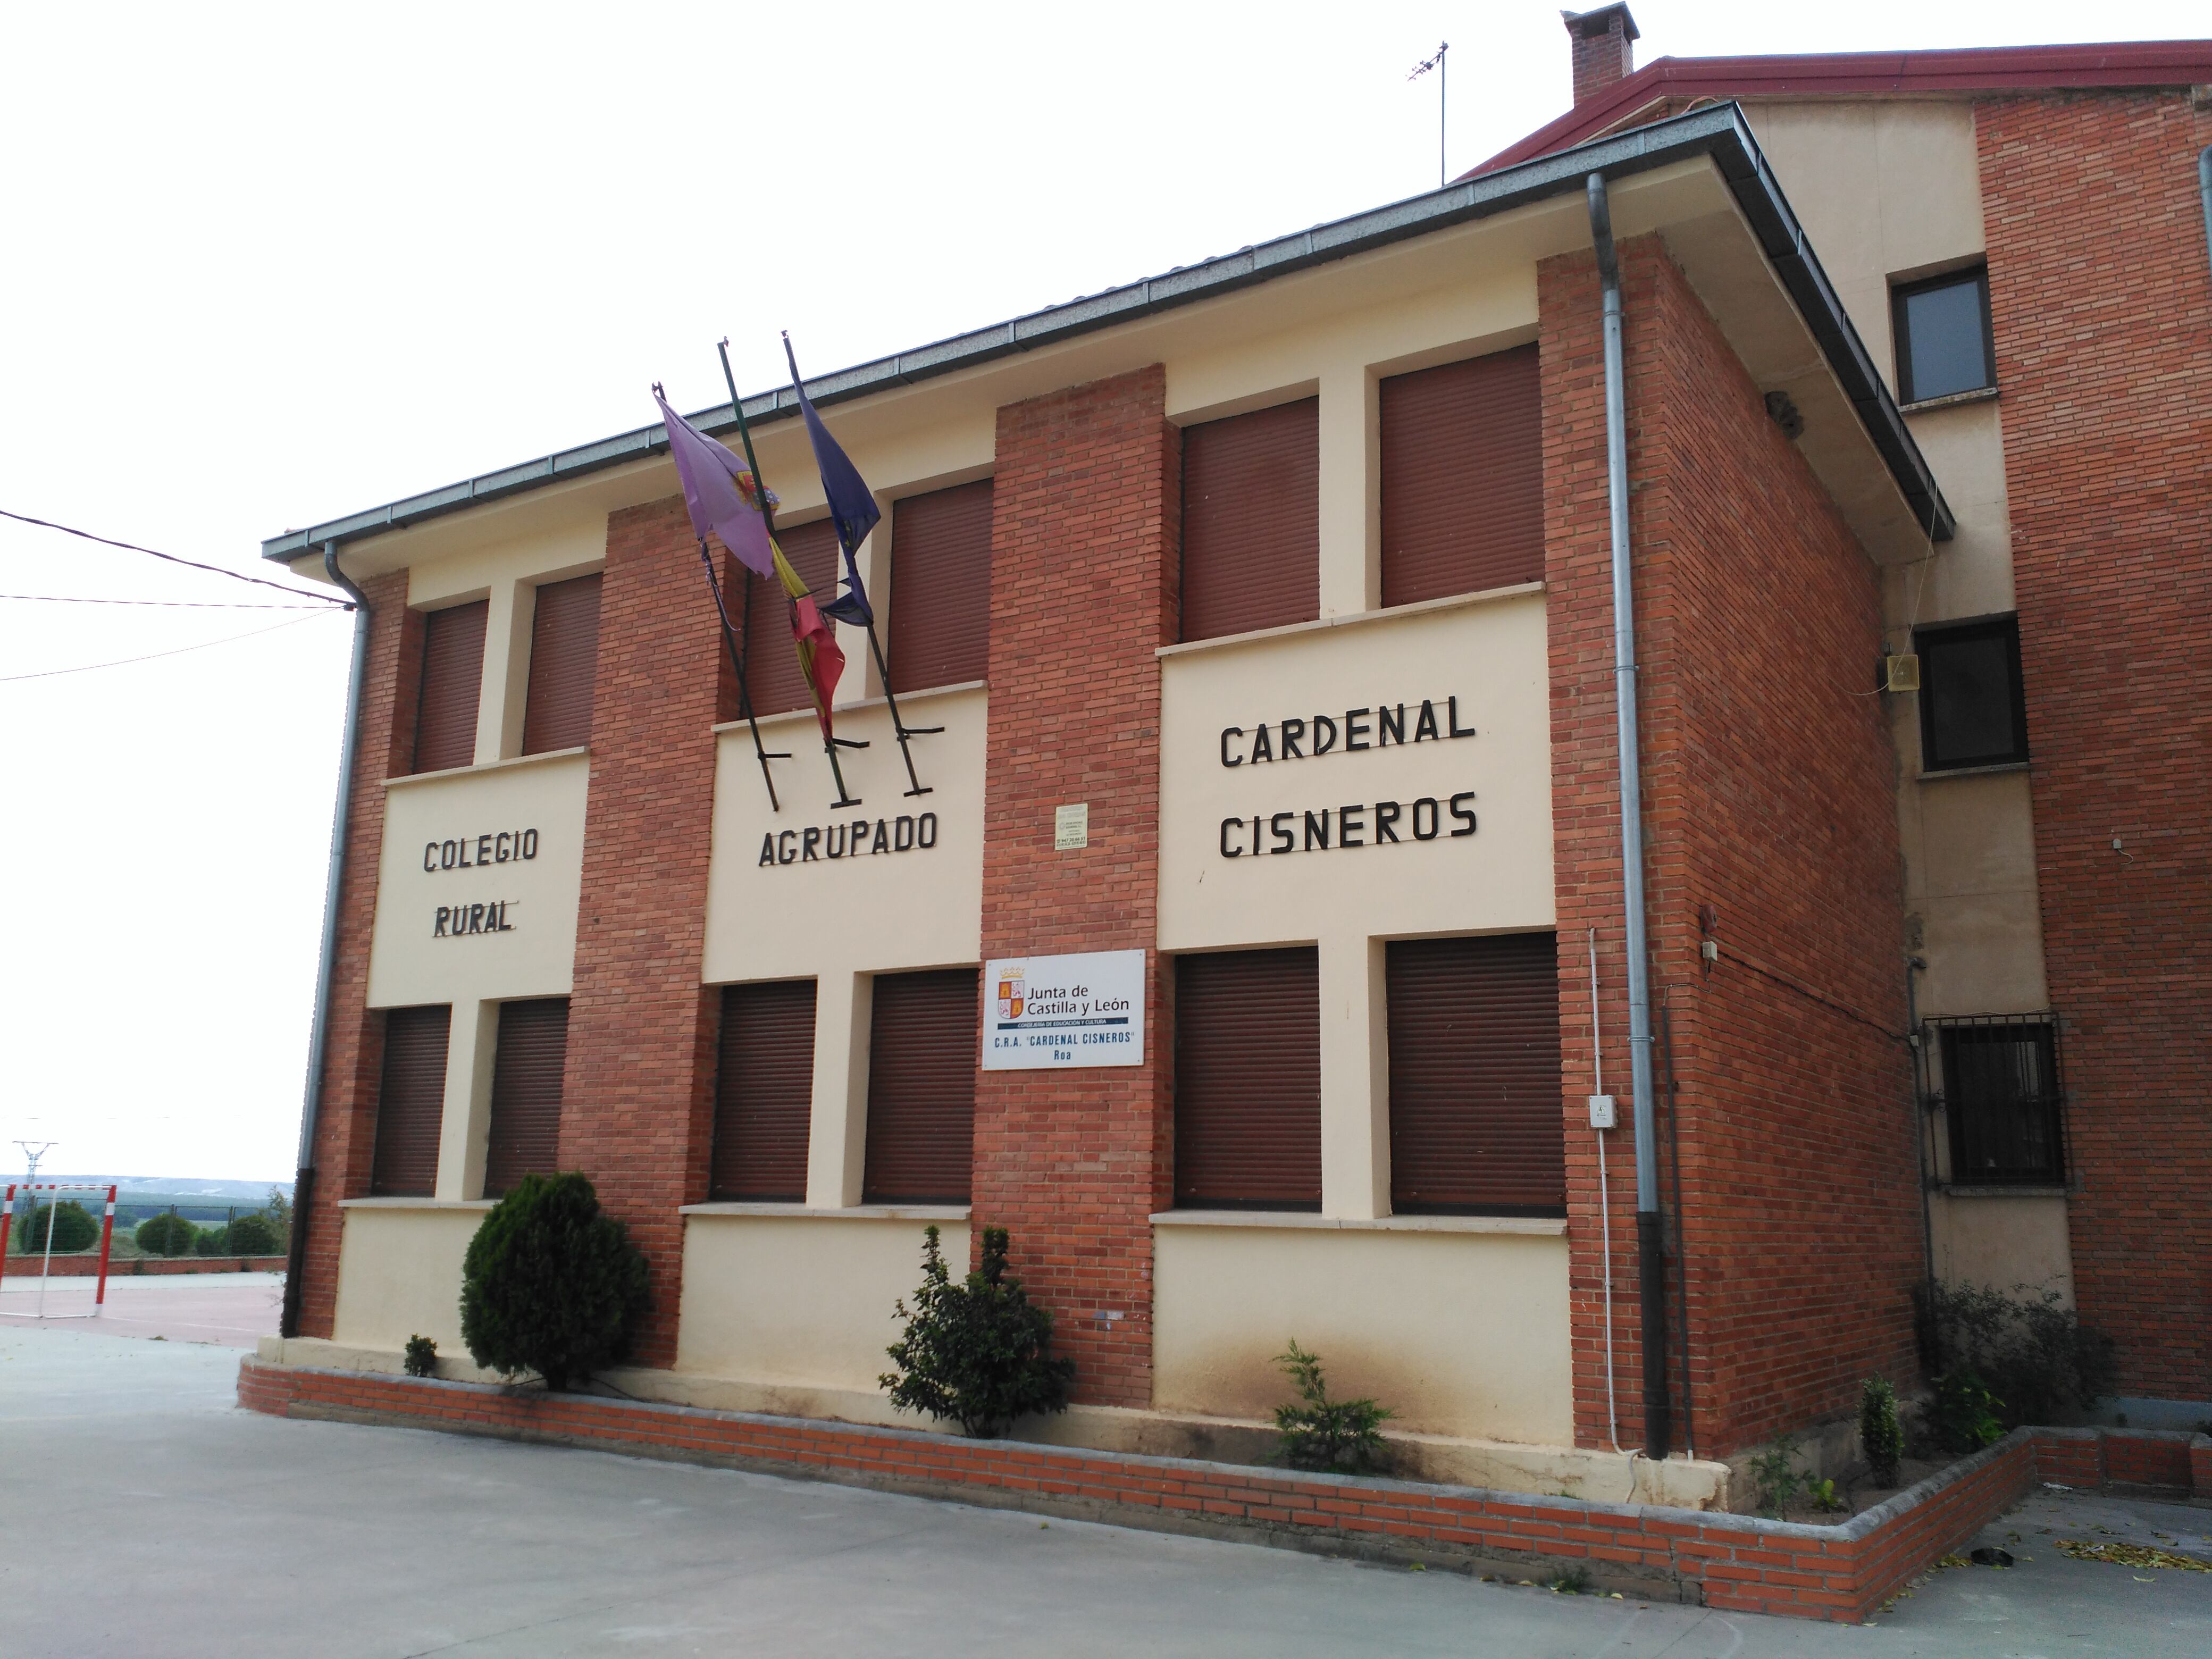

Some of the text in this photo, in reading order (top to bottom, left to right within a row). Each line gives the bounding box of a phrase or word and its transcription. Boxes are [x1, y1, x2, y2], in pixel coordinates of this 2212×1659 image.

[1221, 696, 1474, 767] CARDENAL
[759, 812, 937, 867] AGRUPADO
[1220, 791, 1476, 858] CISNEROS
[424, 828, 538, 872] COLEGIO
[434, 900, 512, 936] RURAL
[1028, 985, 1088, 1000] Junta de
[1028, 998, 1129, 1016] Castilla y León
[995, 1032, 1134, 1048] C.R.A. "CARDENAL CISNEROS"
[1054, 1050, 1071, 1060] Roa
